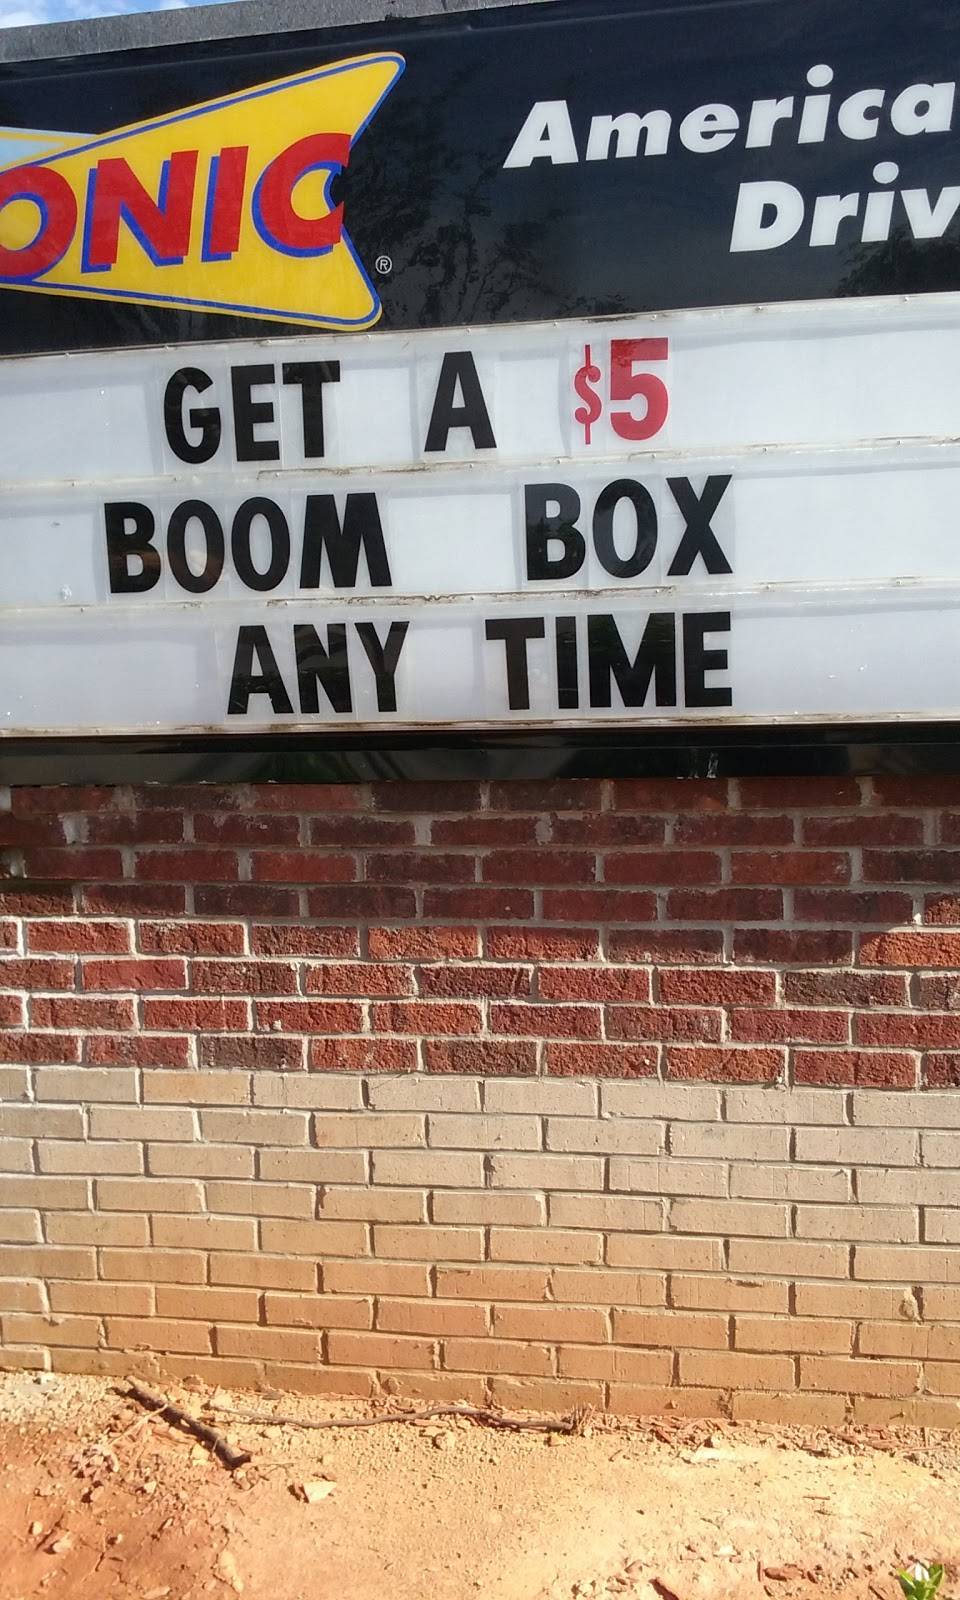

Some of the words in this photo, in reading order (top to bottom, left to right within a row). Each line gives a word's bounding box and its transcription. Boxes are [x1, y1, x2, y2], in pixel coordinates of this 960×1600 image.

[502, 64, 956, 168] America
[729, 161, 960, 252] Driv
[164, 360, 341, 464] GET
[424, 351, 497, 452] A
[574, 337, 669, 445] $5
[104, 492, 393, 594] BOOM
[524, 474, 734, 581] BOX
[227, 621, 410, 715] ANY
[485, 611, 733, 711] TIME
